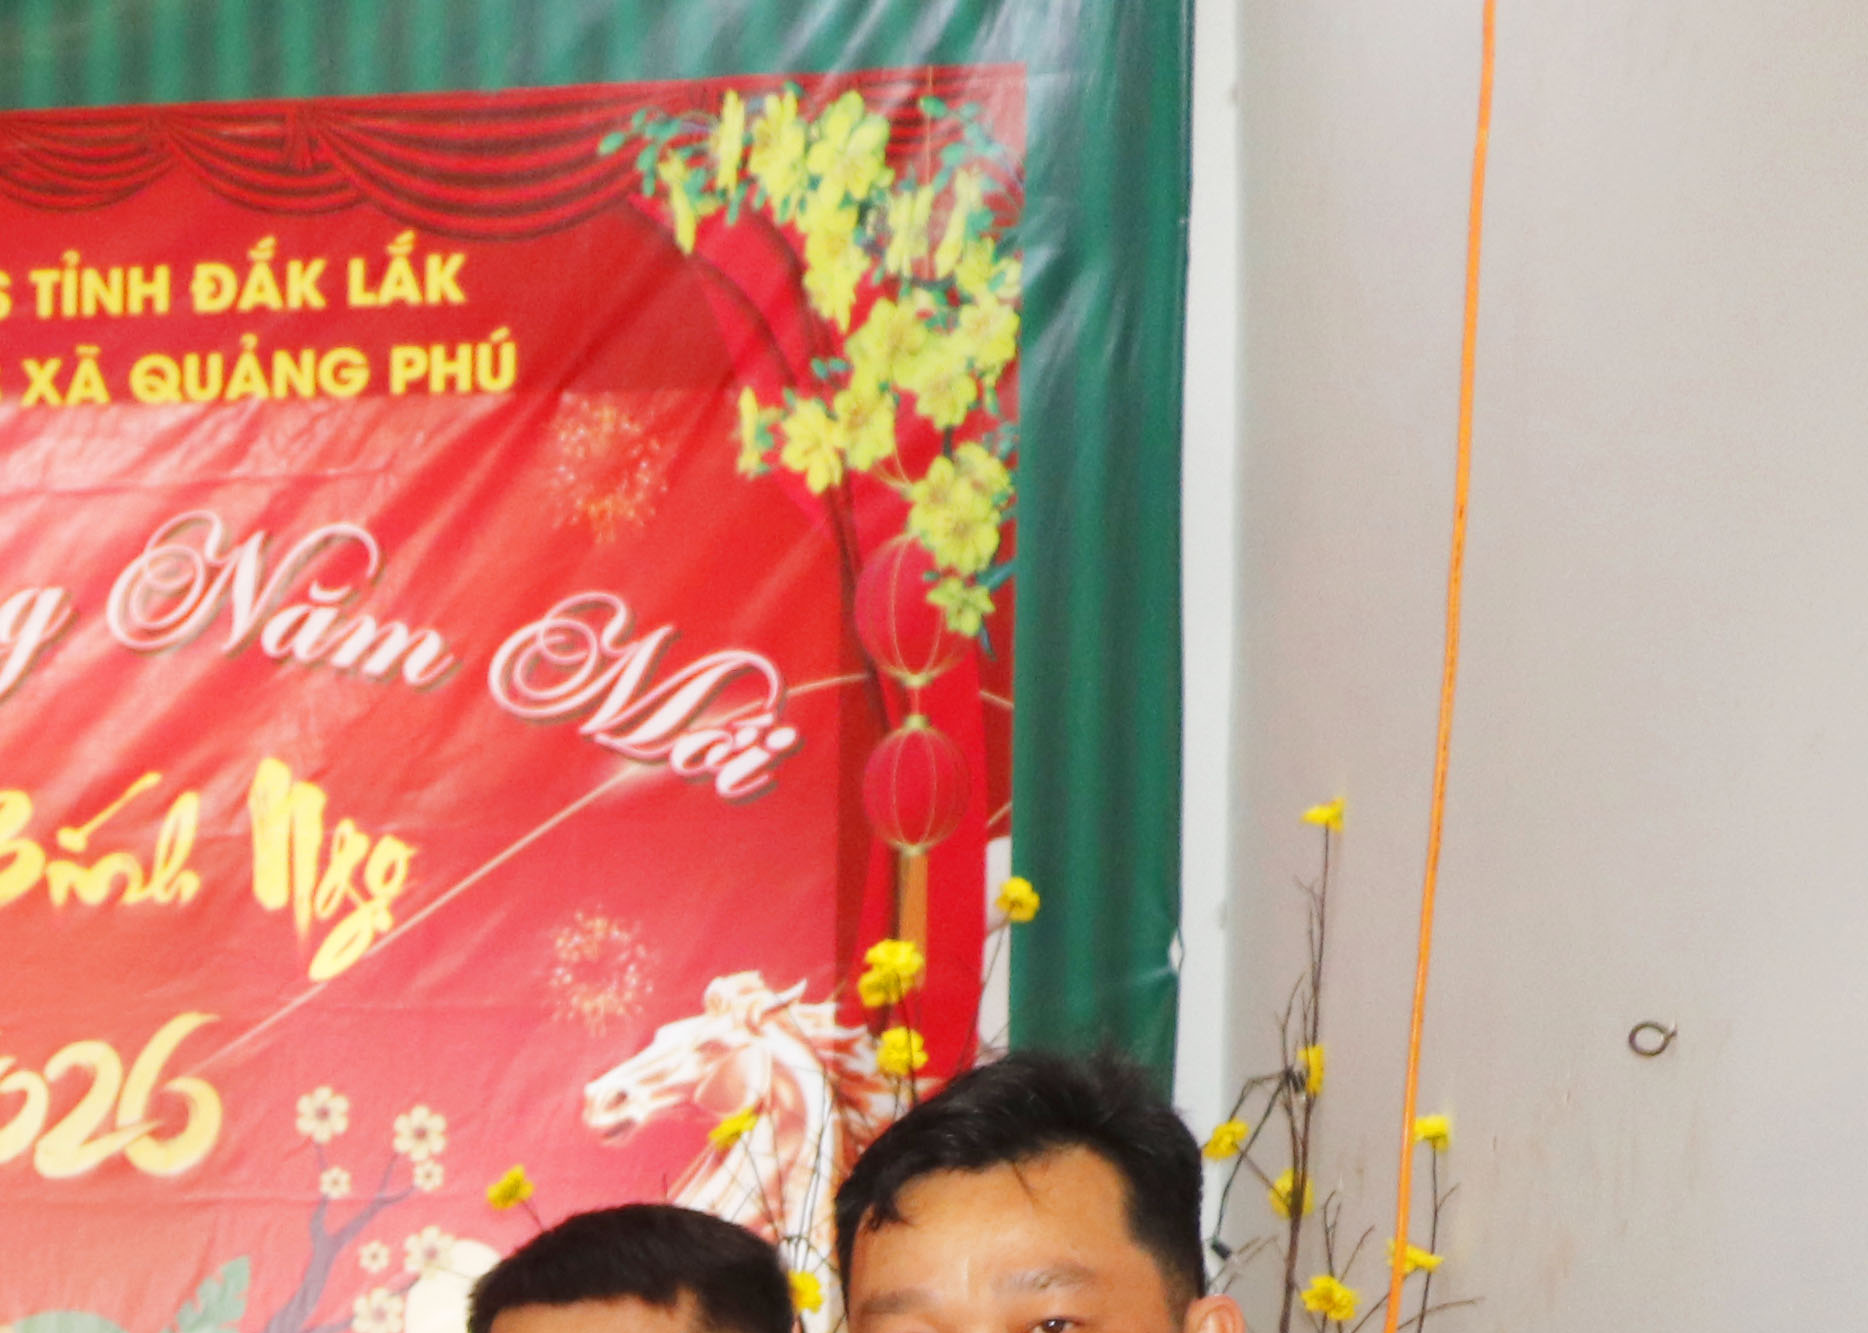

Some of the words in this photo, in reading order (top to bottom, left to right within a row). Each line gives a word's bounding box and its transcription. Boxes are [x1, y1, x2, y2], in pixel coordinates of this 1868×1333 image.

[31, 249, 170, 319] TỈNH
[191, 238, 325, 313] ĐẮK
[347, 230, 465, 307] LẮK
[21, 346, 110, 407] XÃ
[130, 334, 370, 405] QUẢNG
[390, 327, 518, 395] PHÚ
[106, 510, 458, 688] Năm
[489, 591, 799, 800] Mới
